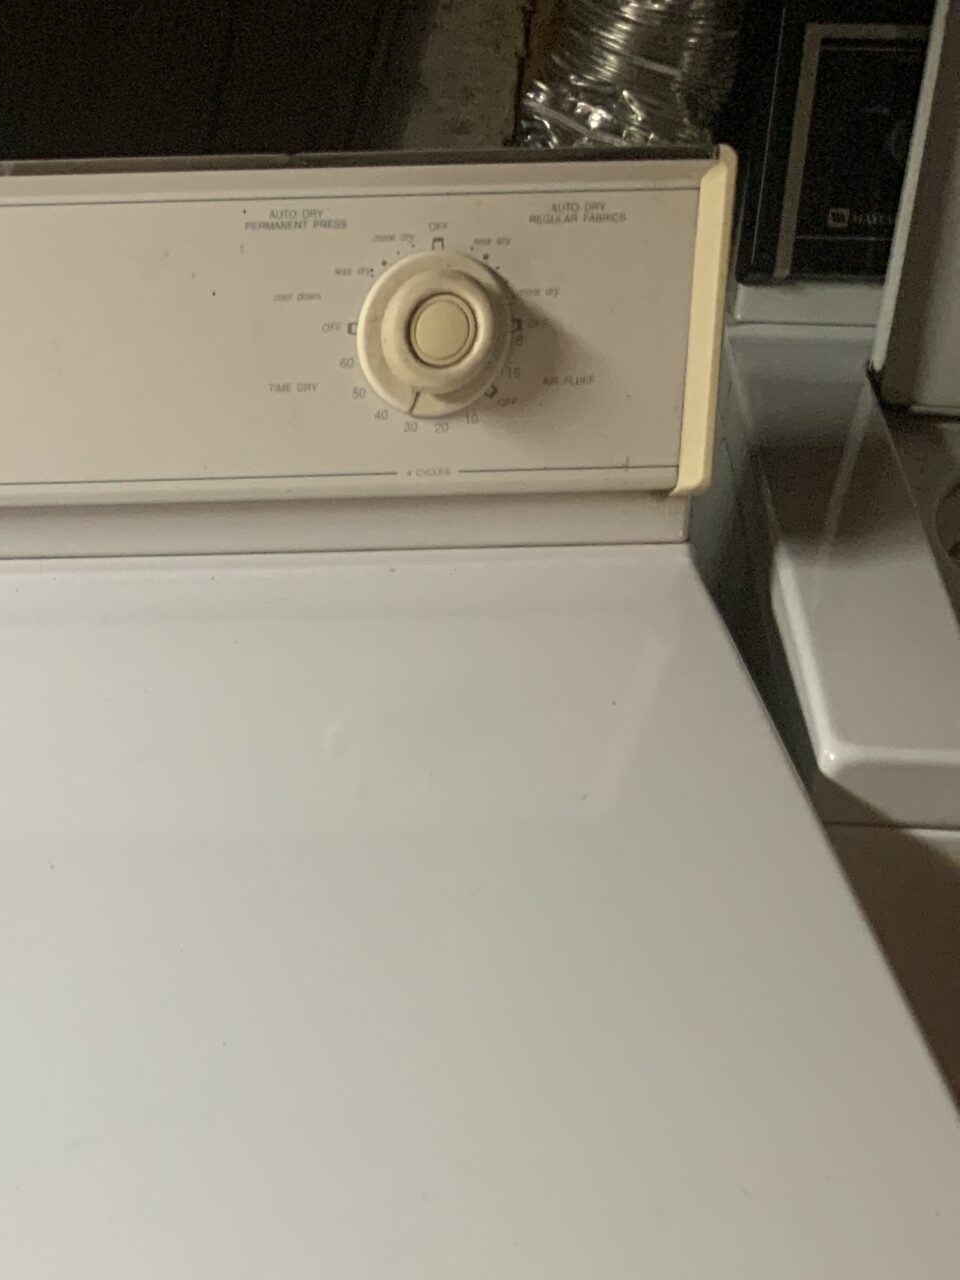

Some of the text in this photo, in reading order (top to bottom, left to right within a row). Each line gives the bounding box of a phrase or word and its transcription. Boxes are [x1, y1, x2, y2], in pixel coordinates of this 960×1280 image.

[552, 202, 606, 212] AUTO DRY
[269, 209, 324, 219] AUTO DRY
[529, 213, 627, 224] REGULAR FABRICS
[245, 219, 348, 230] PERMANENT PRESS
[429, 222, 449, 231] OFF
[340, 357, 354, 368] 60
[269, 382, 318, 393] TIME DRY
[352, 387, 366, 399] 50
[374, 409, 389, 421] 40
[465, 412, 479, 424] 10
[403, 421, 418, 433] 30
[434, 421, 449, 433] 20
